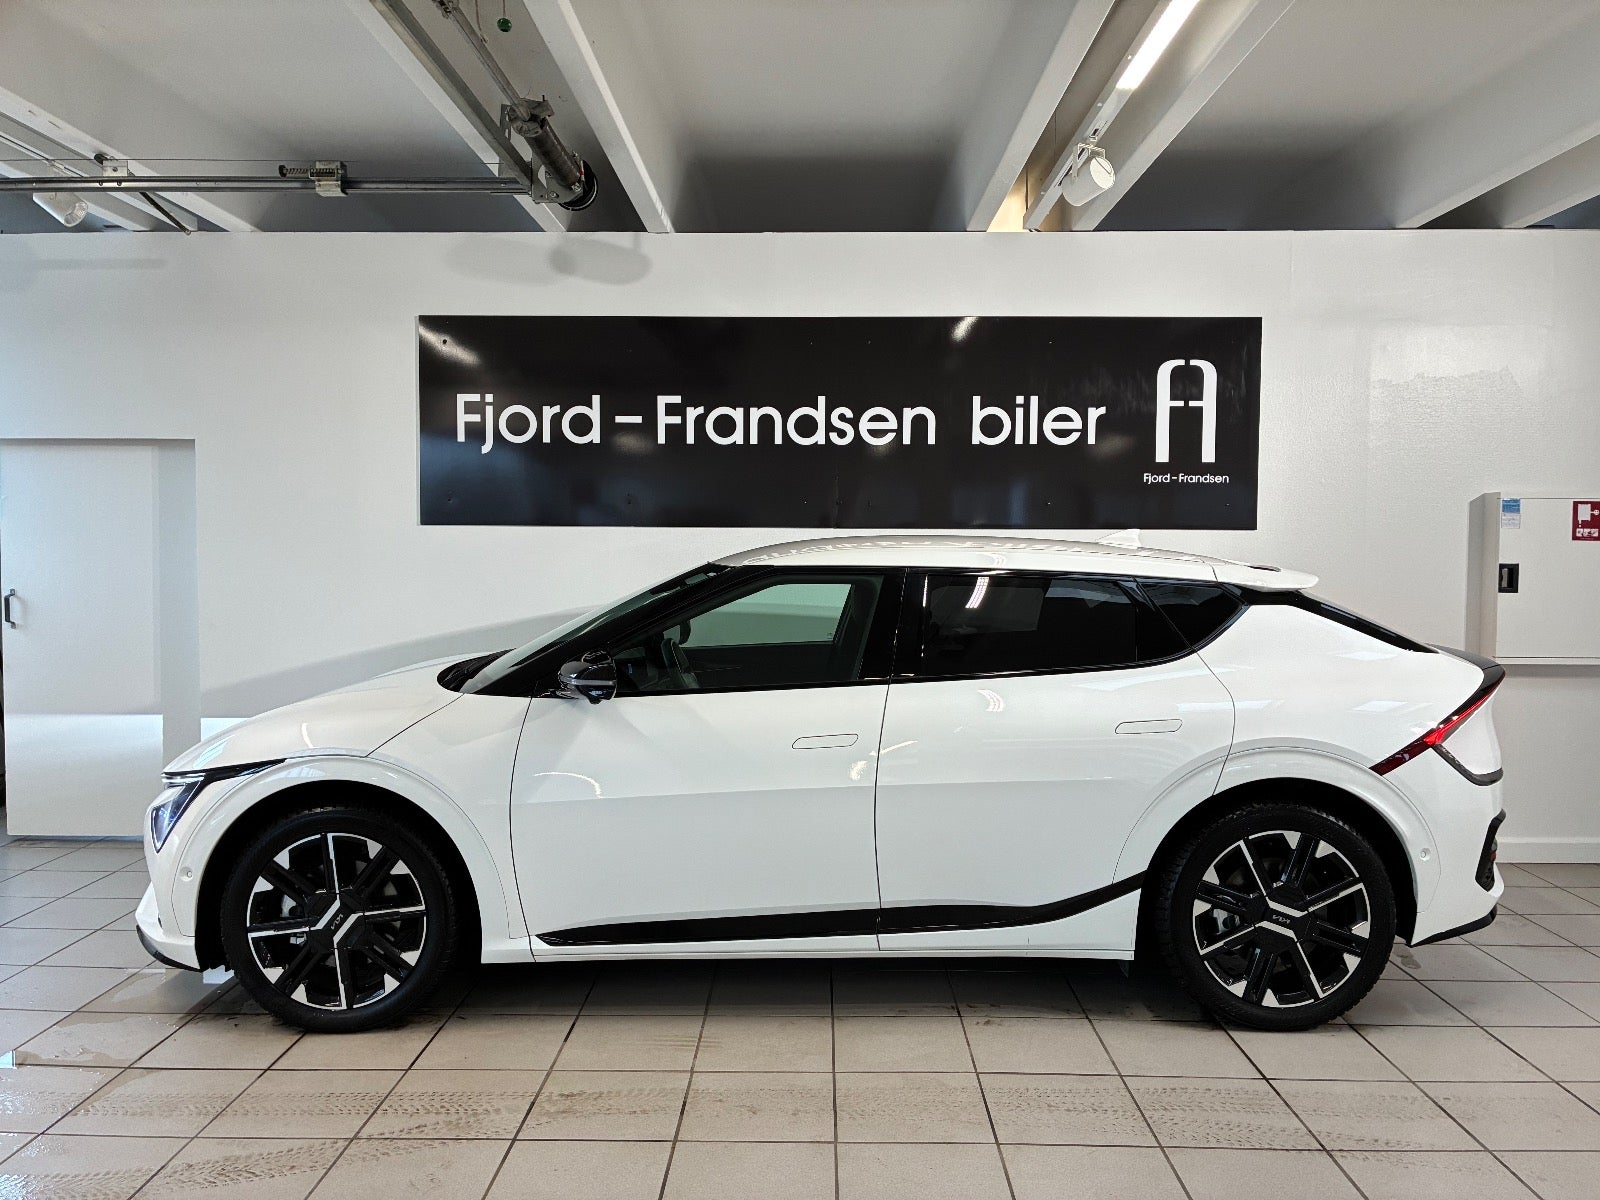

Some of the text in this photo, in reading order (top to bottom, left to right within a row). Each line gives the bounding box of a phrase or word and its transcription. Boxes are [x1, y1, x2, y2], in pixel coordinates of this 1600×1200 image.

[456, 393, 601, 455] Fjord
[656, 395, 936, 446] Frandsen
[971, 395, 1107, 446] biler
